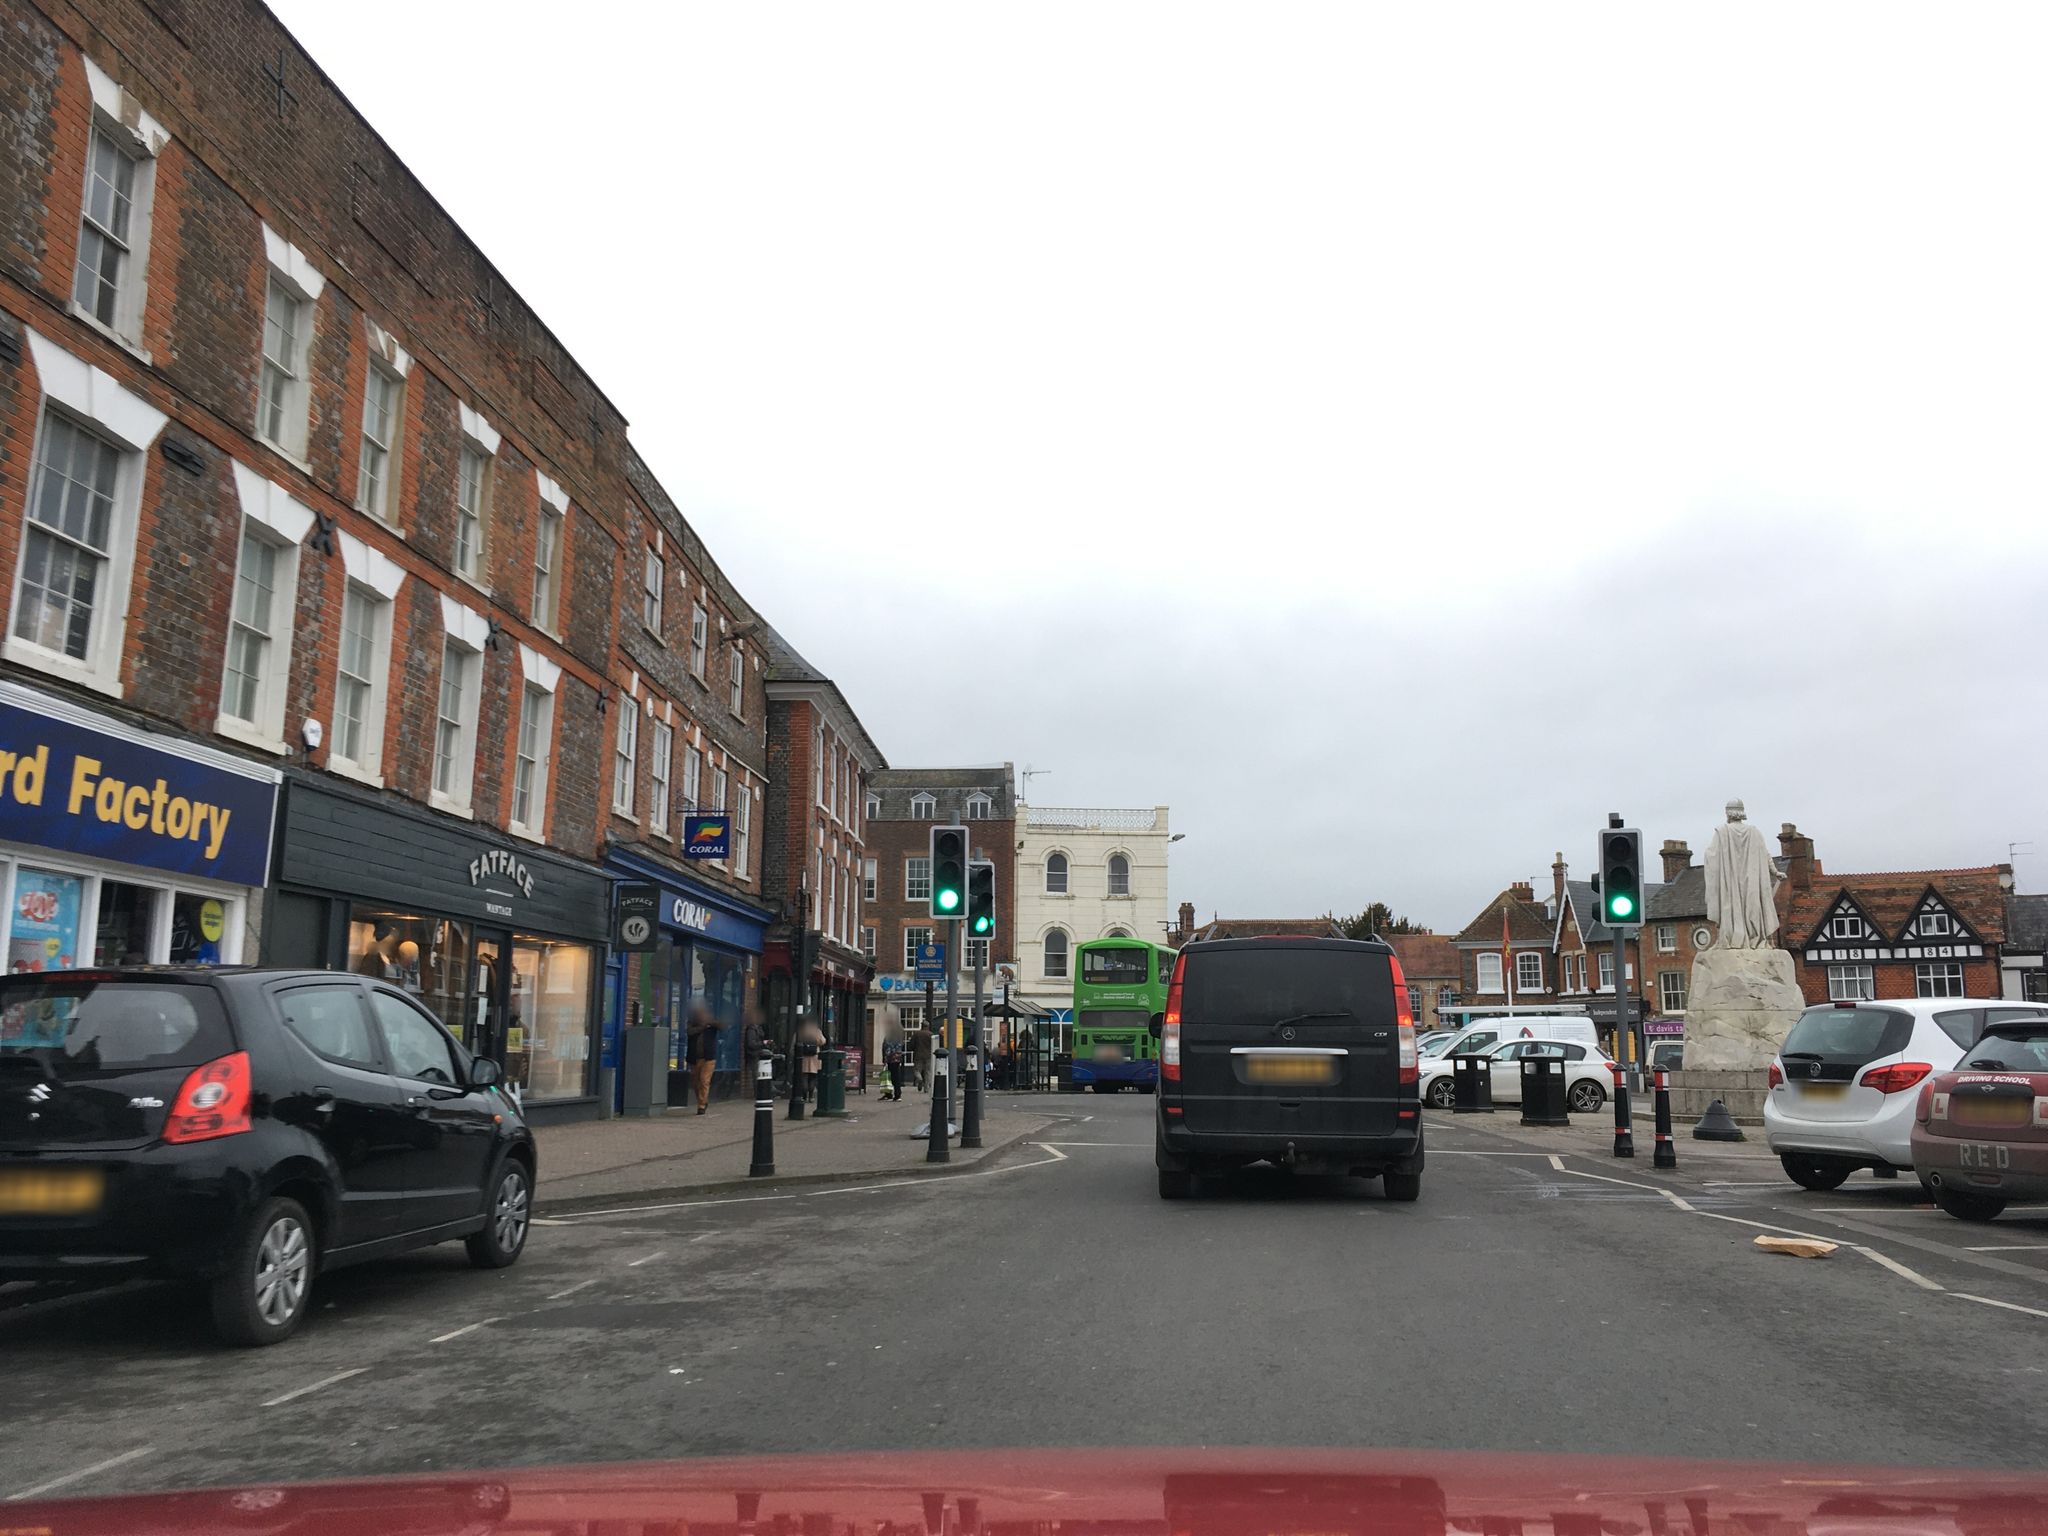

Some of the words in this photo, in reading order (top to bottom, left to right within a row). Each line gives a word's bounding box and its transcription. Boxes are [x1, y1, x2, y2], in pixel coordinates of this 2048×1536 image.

[67, 755, 231, 859] Factory
[689, 845, 725, 853] CORAL
[469, 850, 535, 899] FATFACE
[621, 897, 654, 906] FATFACE
[673, 899, 706, 931] CORAL
[1957, 1075, 1993, 1083] DRIVING
[1993, 1075, 2031, 1085] SCHOOL
[1935, 1097, 1944, 1114] L
[1960, 1143, 2010, 1169] RED
